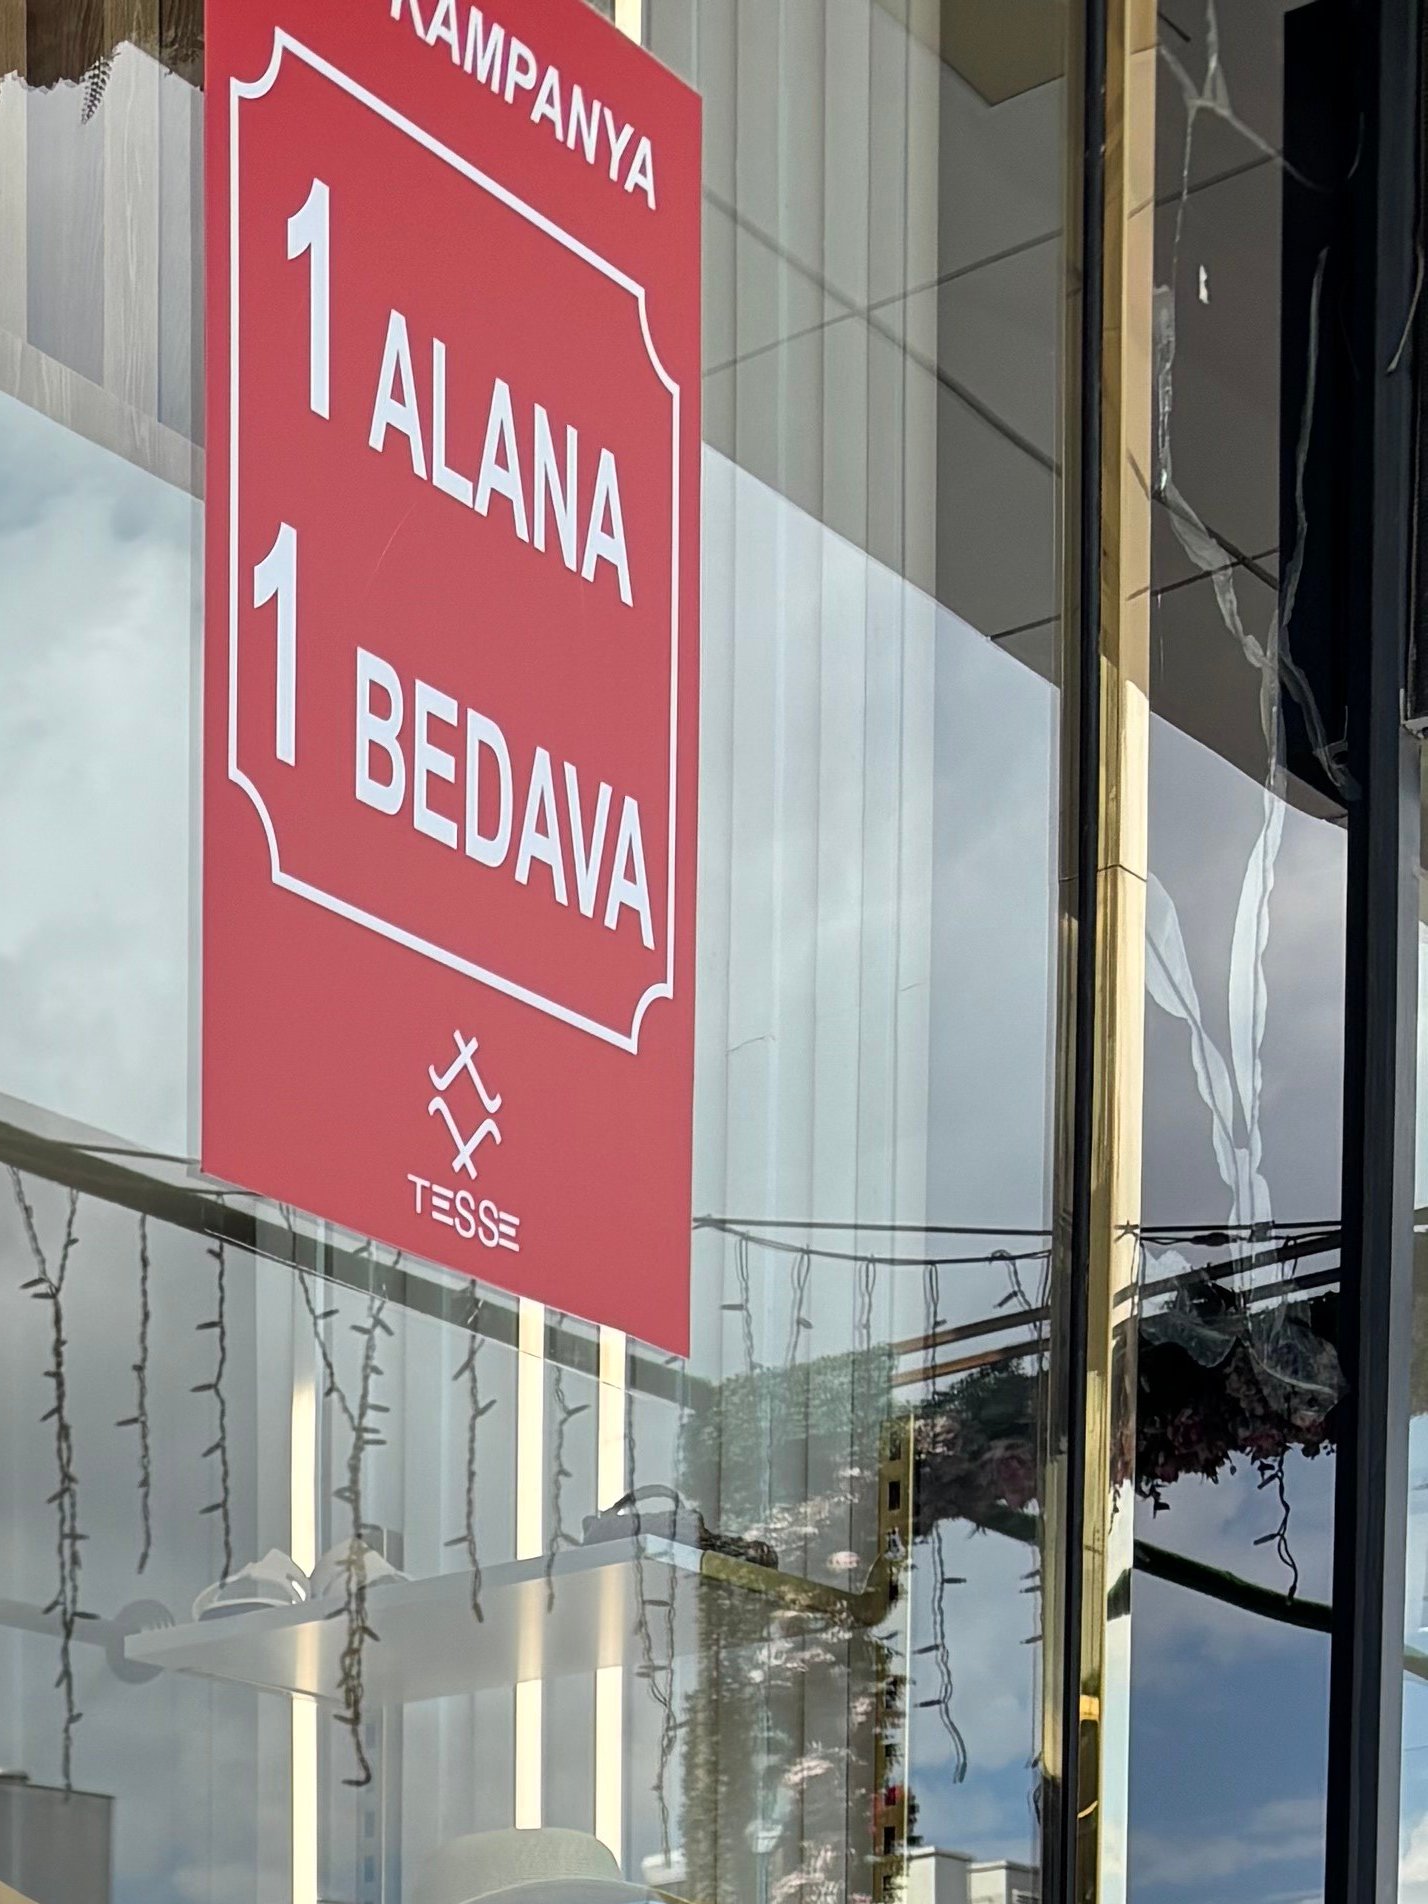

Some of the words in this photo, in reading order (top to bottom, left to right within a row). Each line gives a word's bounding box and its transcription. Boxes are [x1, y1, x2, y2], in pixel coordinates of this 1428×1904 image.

[286, 177, 330, 420] 1
[367, 308, 635, 608] ALANA
[252, 521, 298, 767] 1
[354, 646, 656, 952] BEDAVA
[406, 1173, 521, 1253] TESSE
